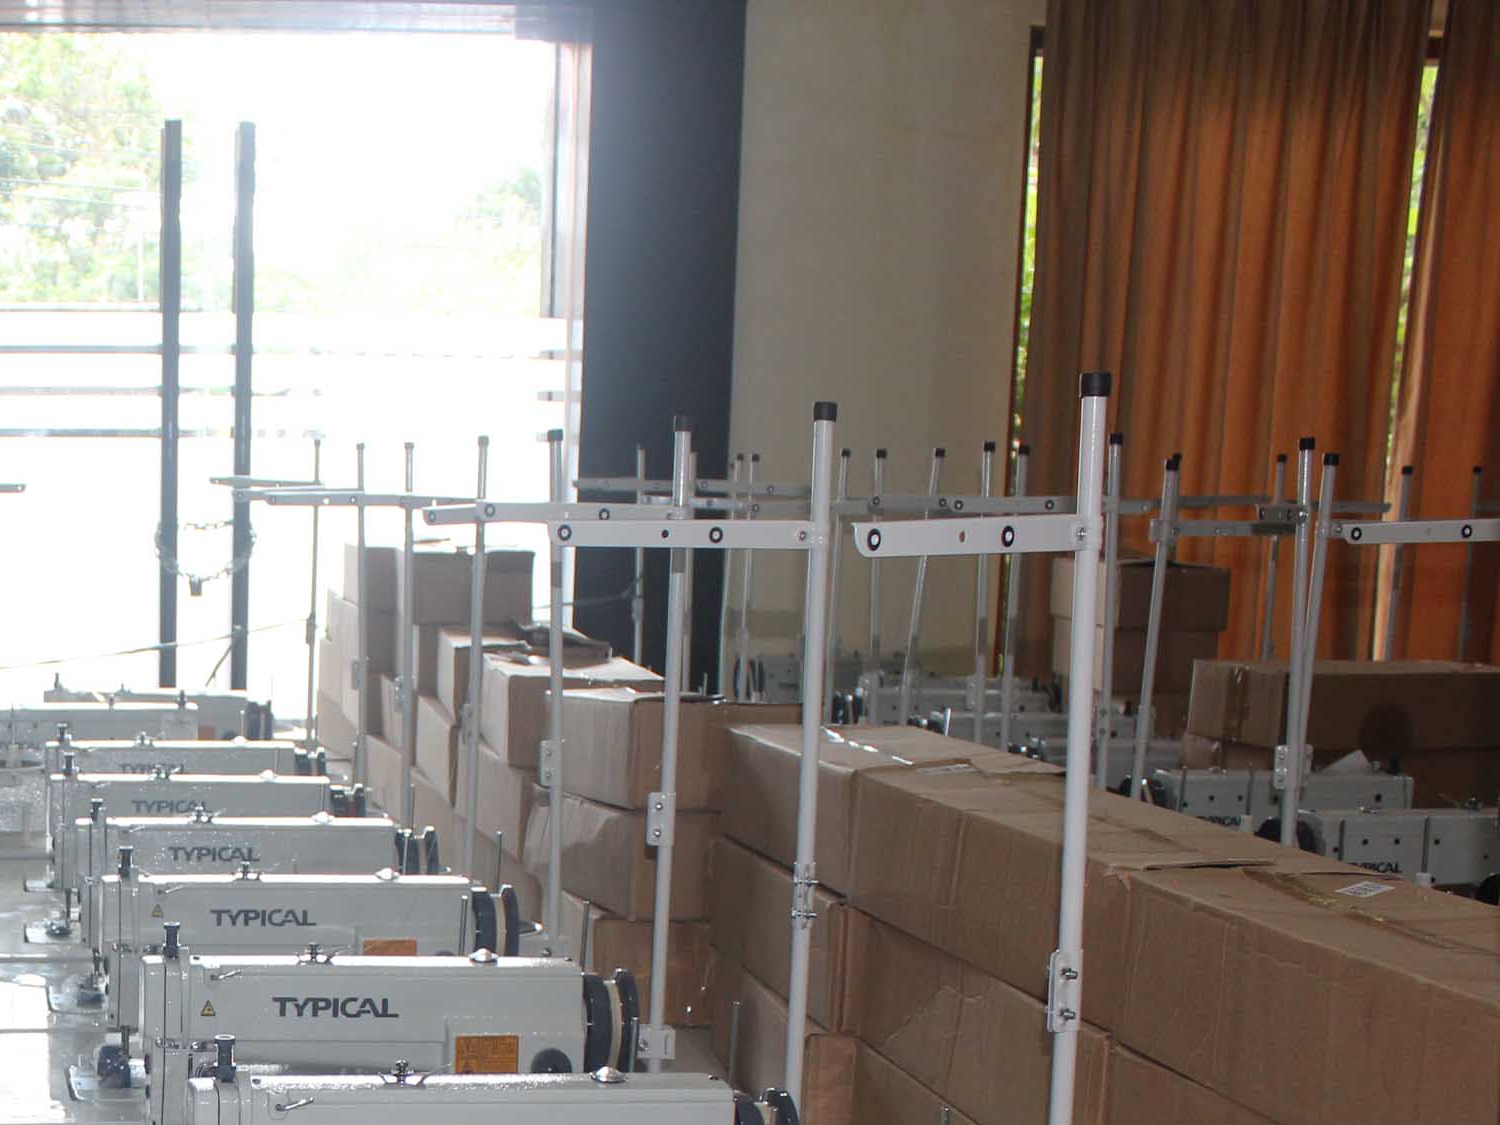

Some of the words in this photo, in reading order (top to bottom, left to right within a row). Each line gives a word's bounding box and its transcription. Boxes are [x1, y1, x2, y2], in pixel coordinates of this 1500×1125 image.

[131, 799, 212, 814] TYPICAL
[168, 846, 261, 863] TYPICAL
[210, 908, 317, 927] TYPICAL
[272, 996, 399, 1019] TYPICAL
